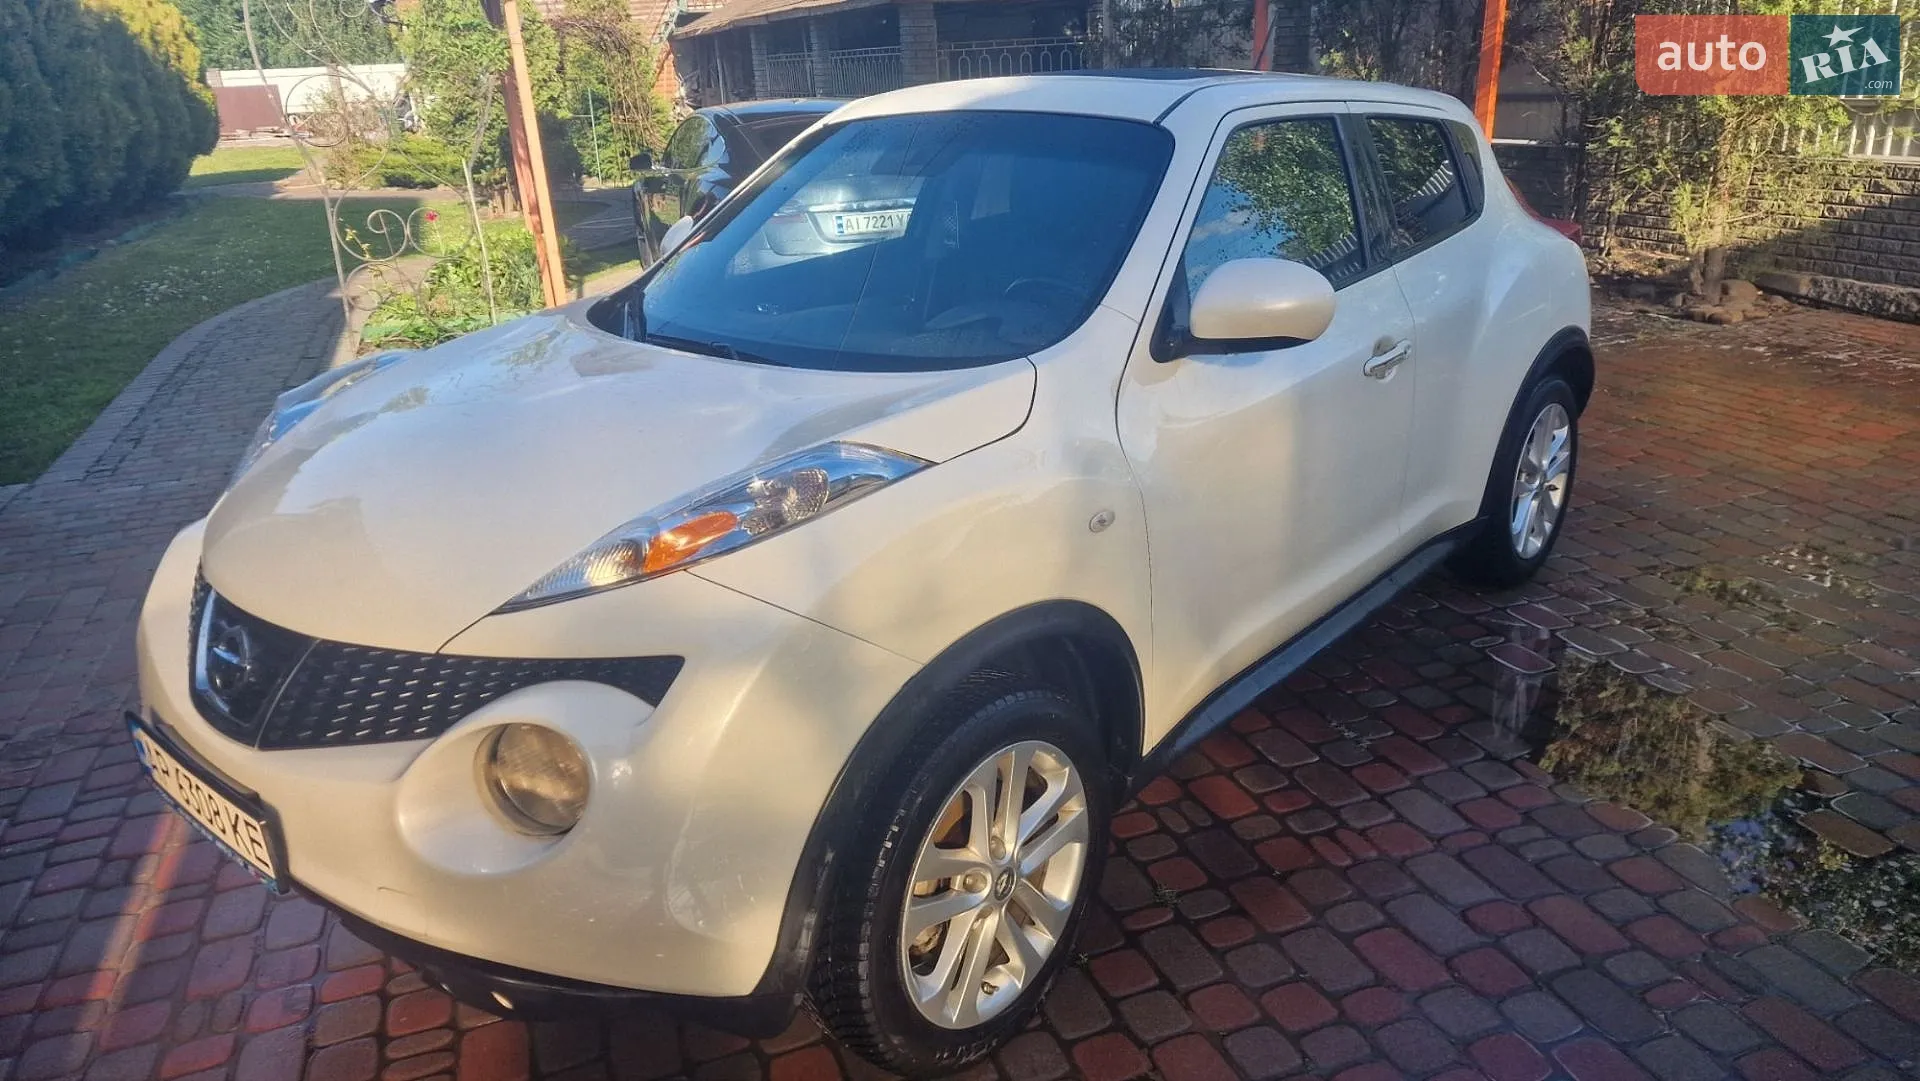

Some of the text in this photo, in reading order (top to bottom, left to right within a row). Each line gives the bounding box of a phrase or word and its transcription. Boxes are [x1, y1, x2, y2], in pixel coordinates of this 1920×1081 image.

[845, 218, 860, 231] AI
[863, 215, 894, 230] 7221
[175, 766, 227, 836] 6308
[223, 803, 271, 870] KE
